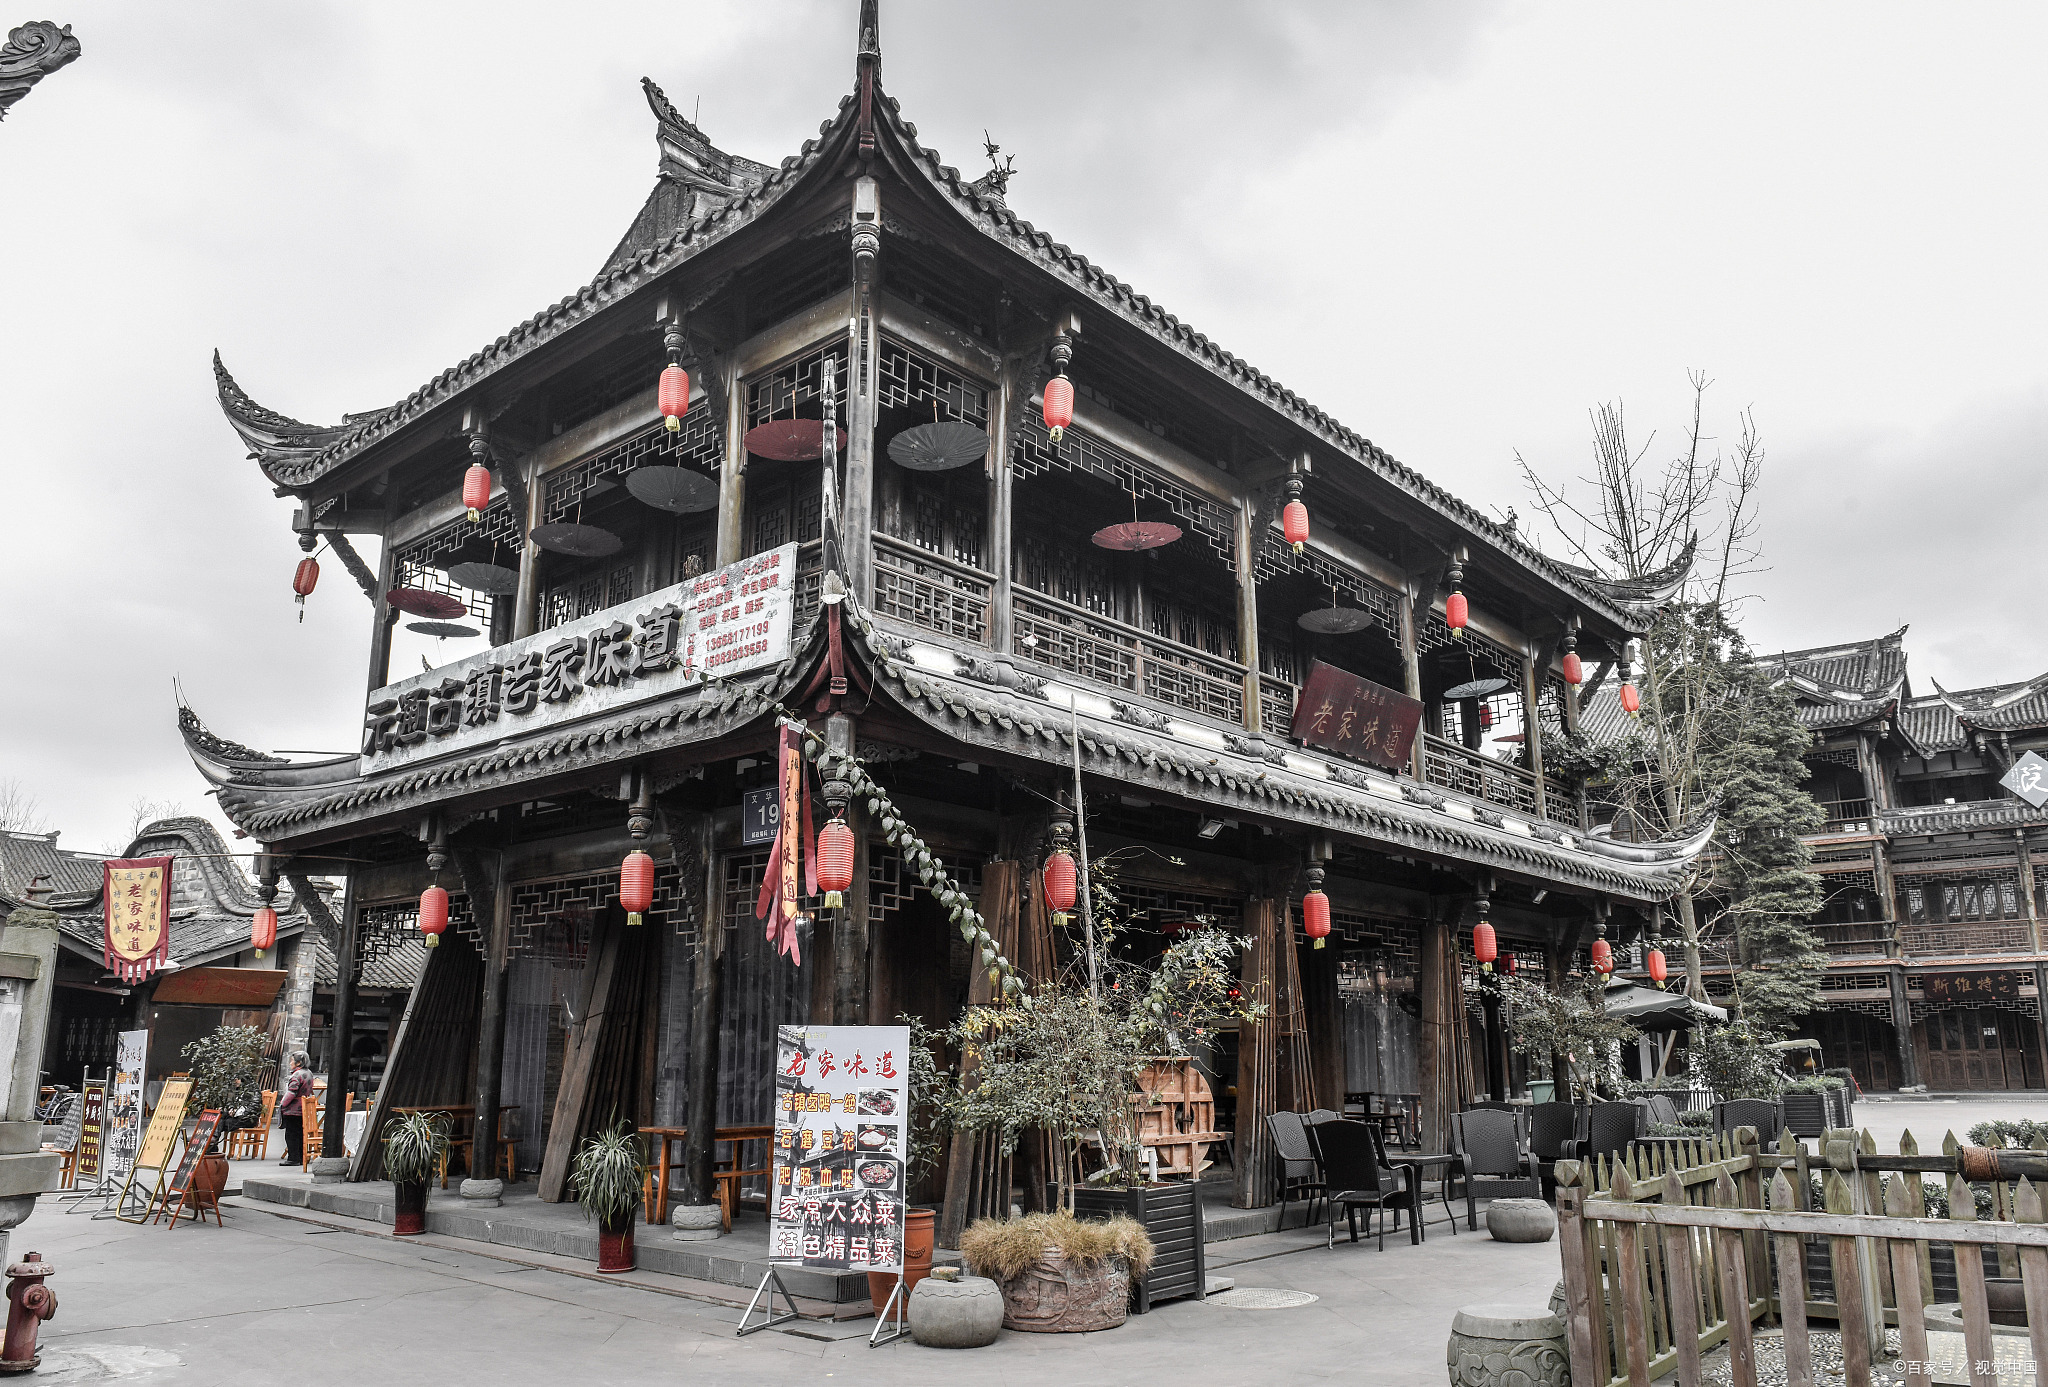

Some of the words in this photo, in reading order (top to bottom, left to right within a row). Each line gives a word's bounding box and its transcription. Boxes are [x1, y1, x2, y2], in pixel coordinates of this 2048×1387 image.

[706, 621, 769, 651] 13668177199
[704, 639, 768, 669] 15982833558
[1310, 699, 1403, 758] 老家味道
[758, 803, 779, 826] 19
[113, 871, 159, 881] 元通古镇
[127, 883, 144, 953] 老家味道
[1932, 976, 1993, 995] 斯维特
[785, 1047, 898, 1080] 老家味道
[782, 1092, 856, 1114] 古镇卤鸭一绝
[780, 1129, 855, 1151] 石磨豆花
[778, 1166, 854, 1189] 肥肠血旺
[779, 1195, 896, 1226] 家常大众菜
[778, 1232, 895, 1263] 特色精品菜
